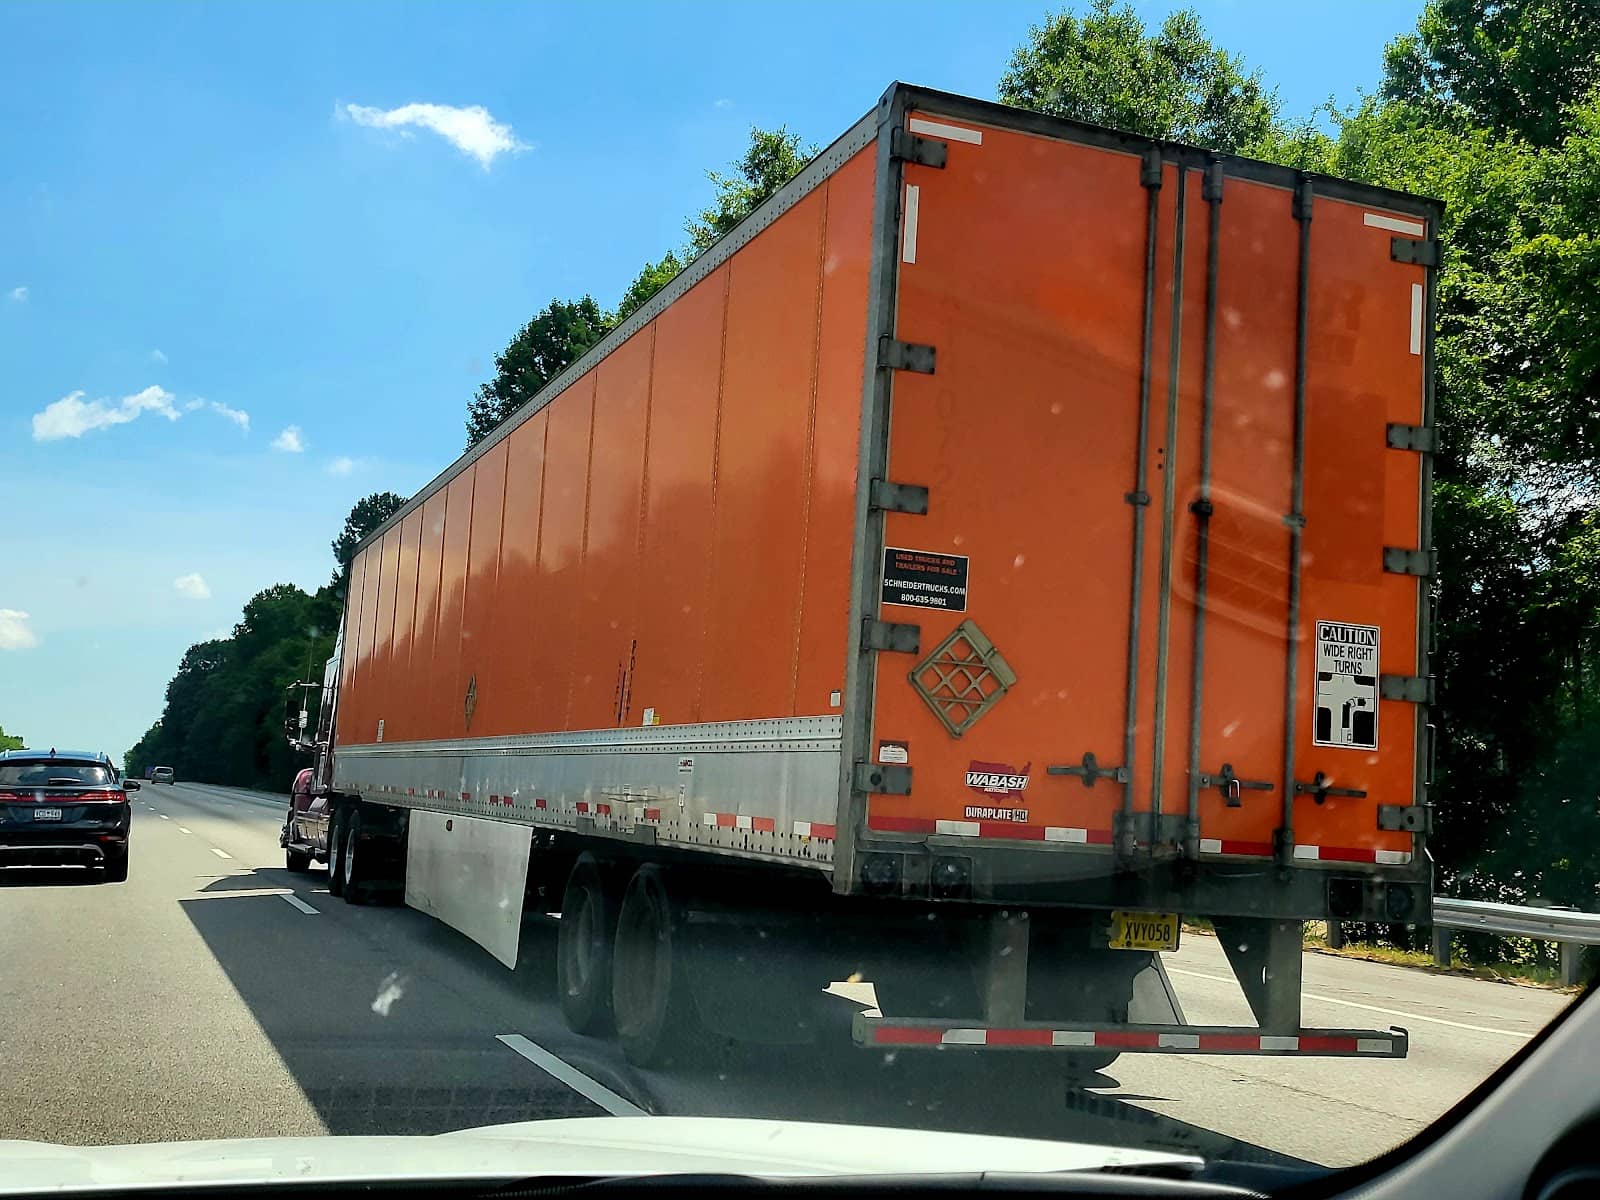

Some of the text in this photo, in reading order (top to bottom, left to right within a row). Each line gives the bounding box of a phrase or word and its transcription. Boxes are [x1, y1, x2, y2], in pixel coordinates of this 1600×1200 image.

[884, 578, 965, 596] SCHNEIDERTRUCKS.COM
[1320, 626, 1376, 646] CAUTION
[1323, 643, 1374, 661] WIDE RIGHT
[1333, 660, 1362, 674] TURNS
[966, 773, 1027, 789] WABASH
[965, 806, 1012, 820] DURAPLATE
[1125, 921, 1170, 941] XVY058
